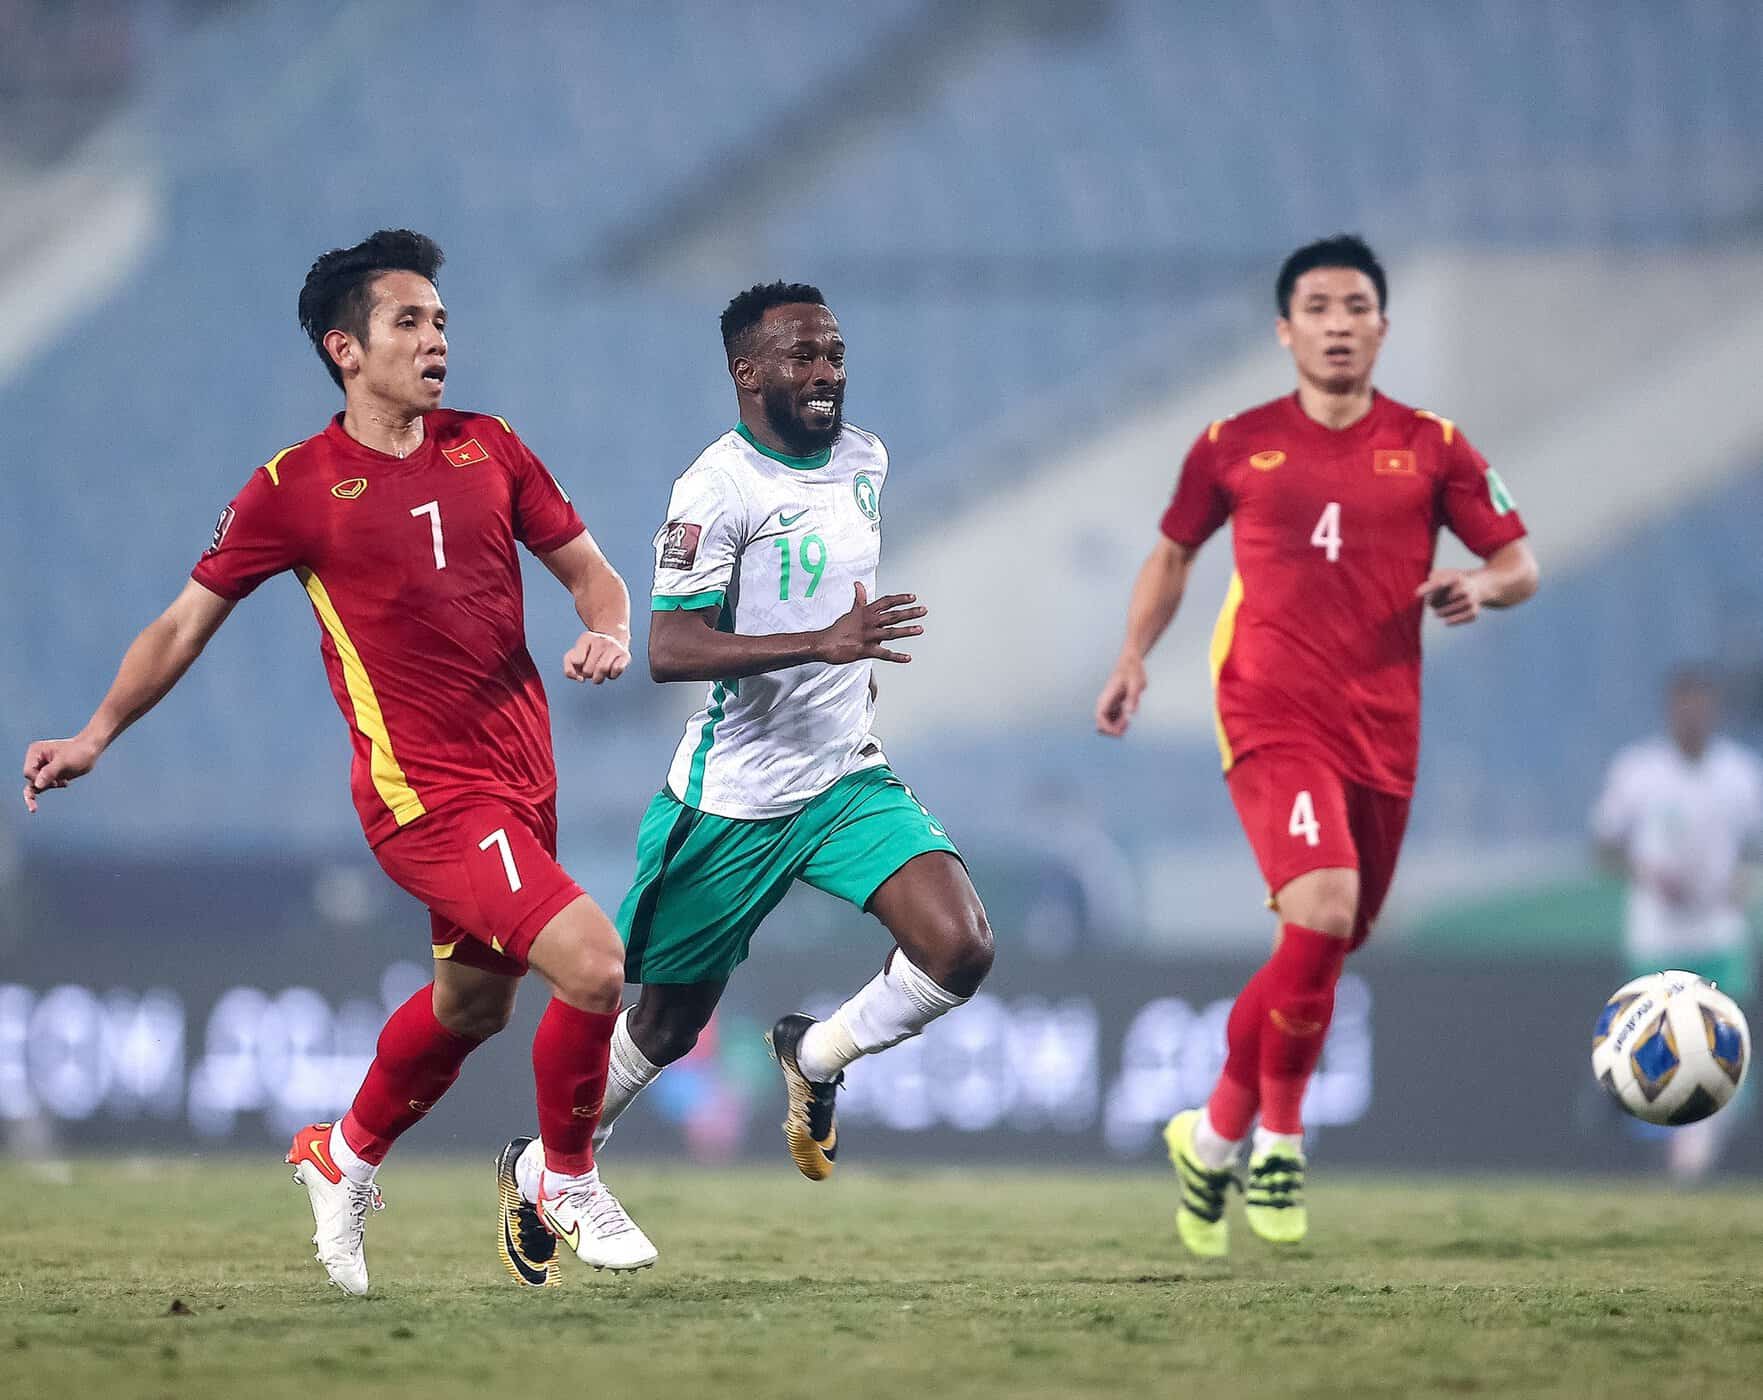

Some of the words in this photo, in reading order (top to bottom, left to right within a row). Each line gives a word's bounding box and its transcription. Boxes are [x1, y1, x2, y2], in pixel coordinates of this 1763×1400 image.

[409, 500, 446, 570] 7
[1311, 502, 1343, 561] 4
[774, 534, 826, 600] 19
[1289, 790, 1320, 846] 4
[478, 828, 522, 893] 7
